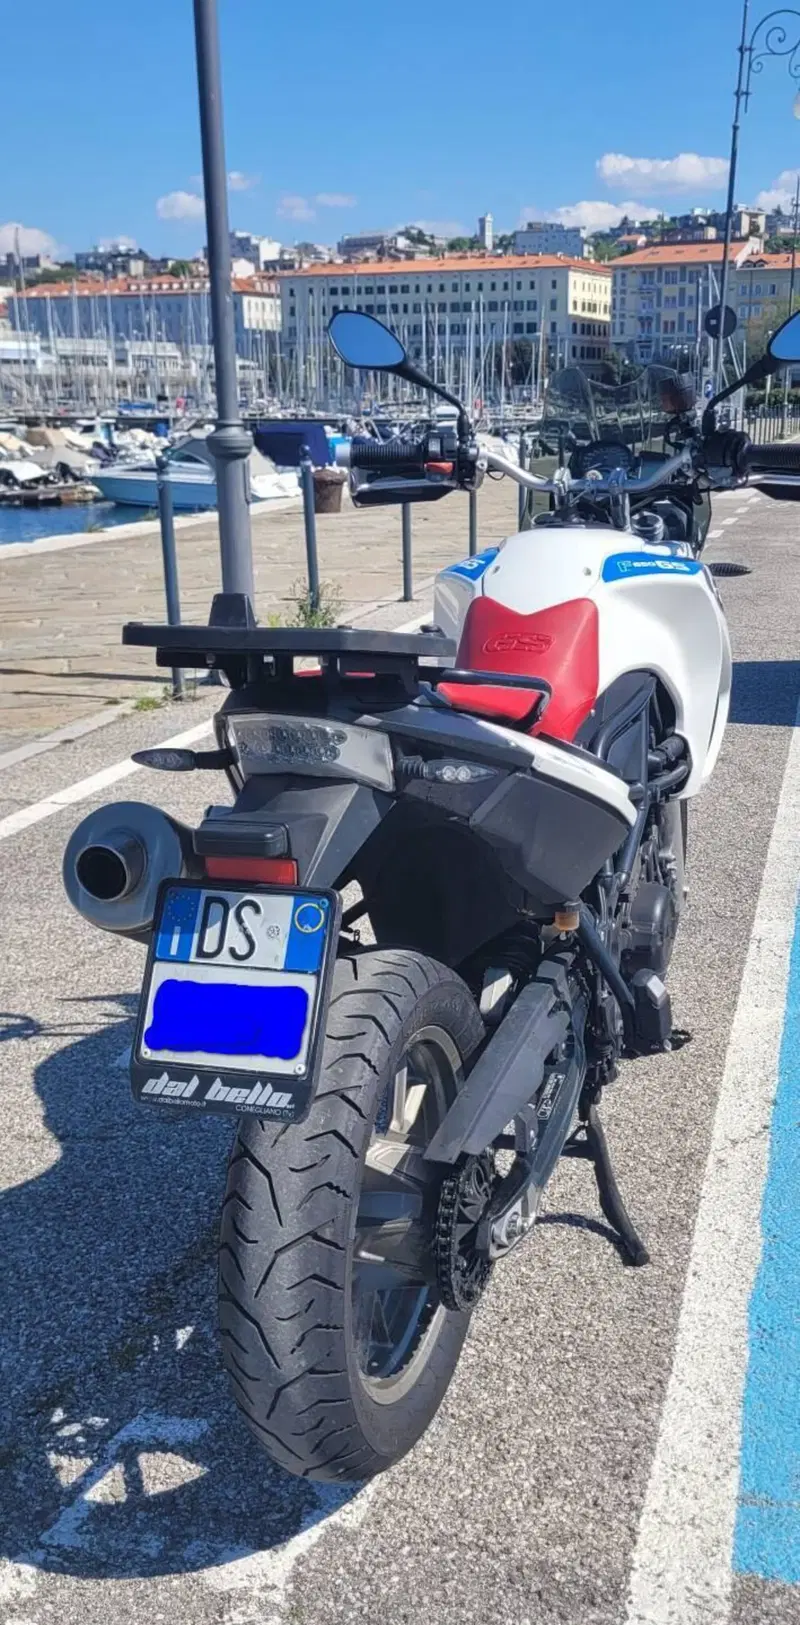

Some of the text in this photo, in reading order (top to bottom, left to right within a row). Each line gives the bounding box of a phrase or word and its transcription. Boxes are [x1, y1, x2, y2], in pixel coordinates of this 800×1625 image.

[196, 896, 262, 961] DS
[141, 1071, 200, 1098] dal
[204, 1077, 293, 1109] bello
[235, 1104, 282, 1116] CONEGLIANO
